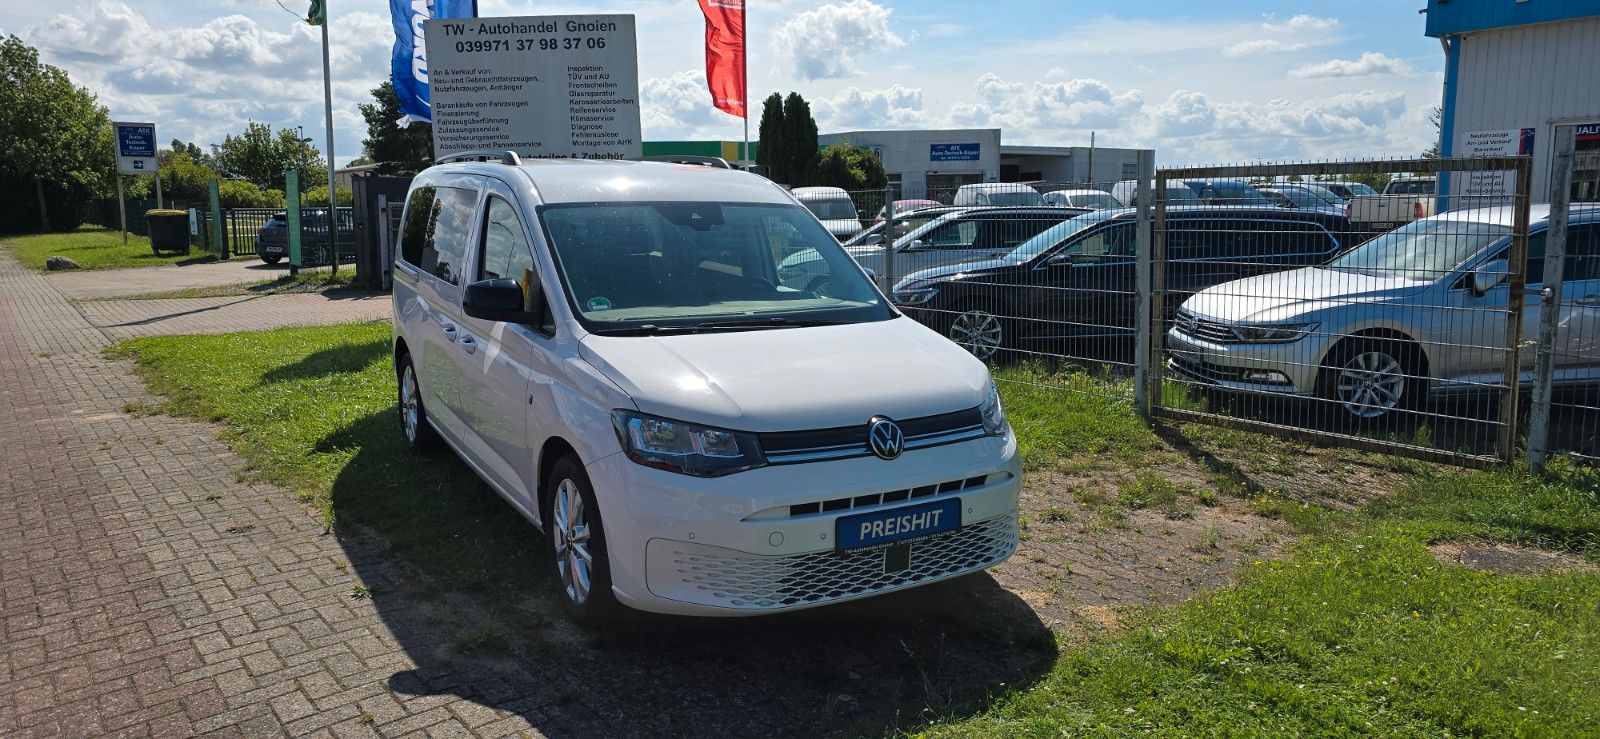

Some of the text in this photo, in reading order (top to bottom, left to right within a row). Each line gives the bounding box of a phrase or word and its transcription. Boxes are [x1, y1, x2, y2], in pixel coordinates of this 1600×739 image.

[443, 24, 465, 36] TW
[478, 21, 558, 35] Autohandel
[566, 20, 616, 32] Gnoien
[456, 37, 606, 53] 039971 37 98 37 06
[450, 68, 476, 76] Verkauf
[567, 65, 603, 73] Inspektion
[568, 81, 618, 89] Frontscheiben
[569, 90, 616, 98] Glasreparatur
[436, 101, 473, 109] Barankäufe
[489, 100, 529, 108] Fahrzeugen
[569, 98, 634, 106] Karosseriearbeiten
[437, 110, 480, 118] Finanzierung
[570, 114, 615, 122] Klimaservice
[437, 117, 509, 126] Fahrzeugüberführung
[438, 126, 500, 134] Zulassungsservice
[439, 134, 510, 142] Versicherungsservice
[440, 140, 542, 150] Abschlepp- und Pannenservice
[572, 139, 601, 147] Montage
[617, 138, 633, 146] AHK
[860, 509, 944, 541] PREISHIT
